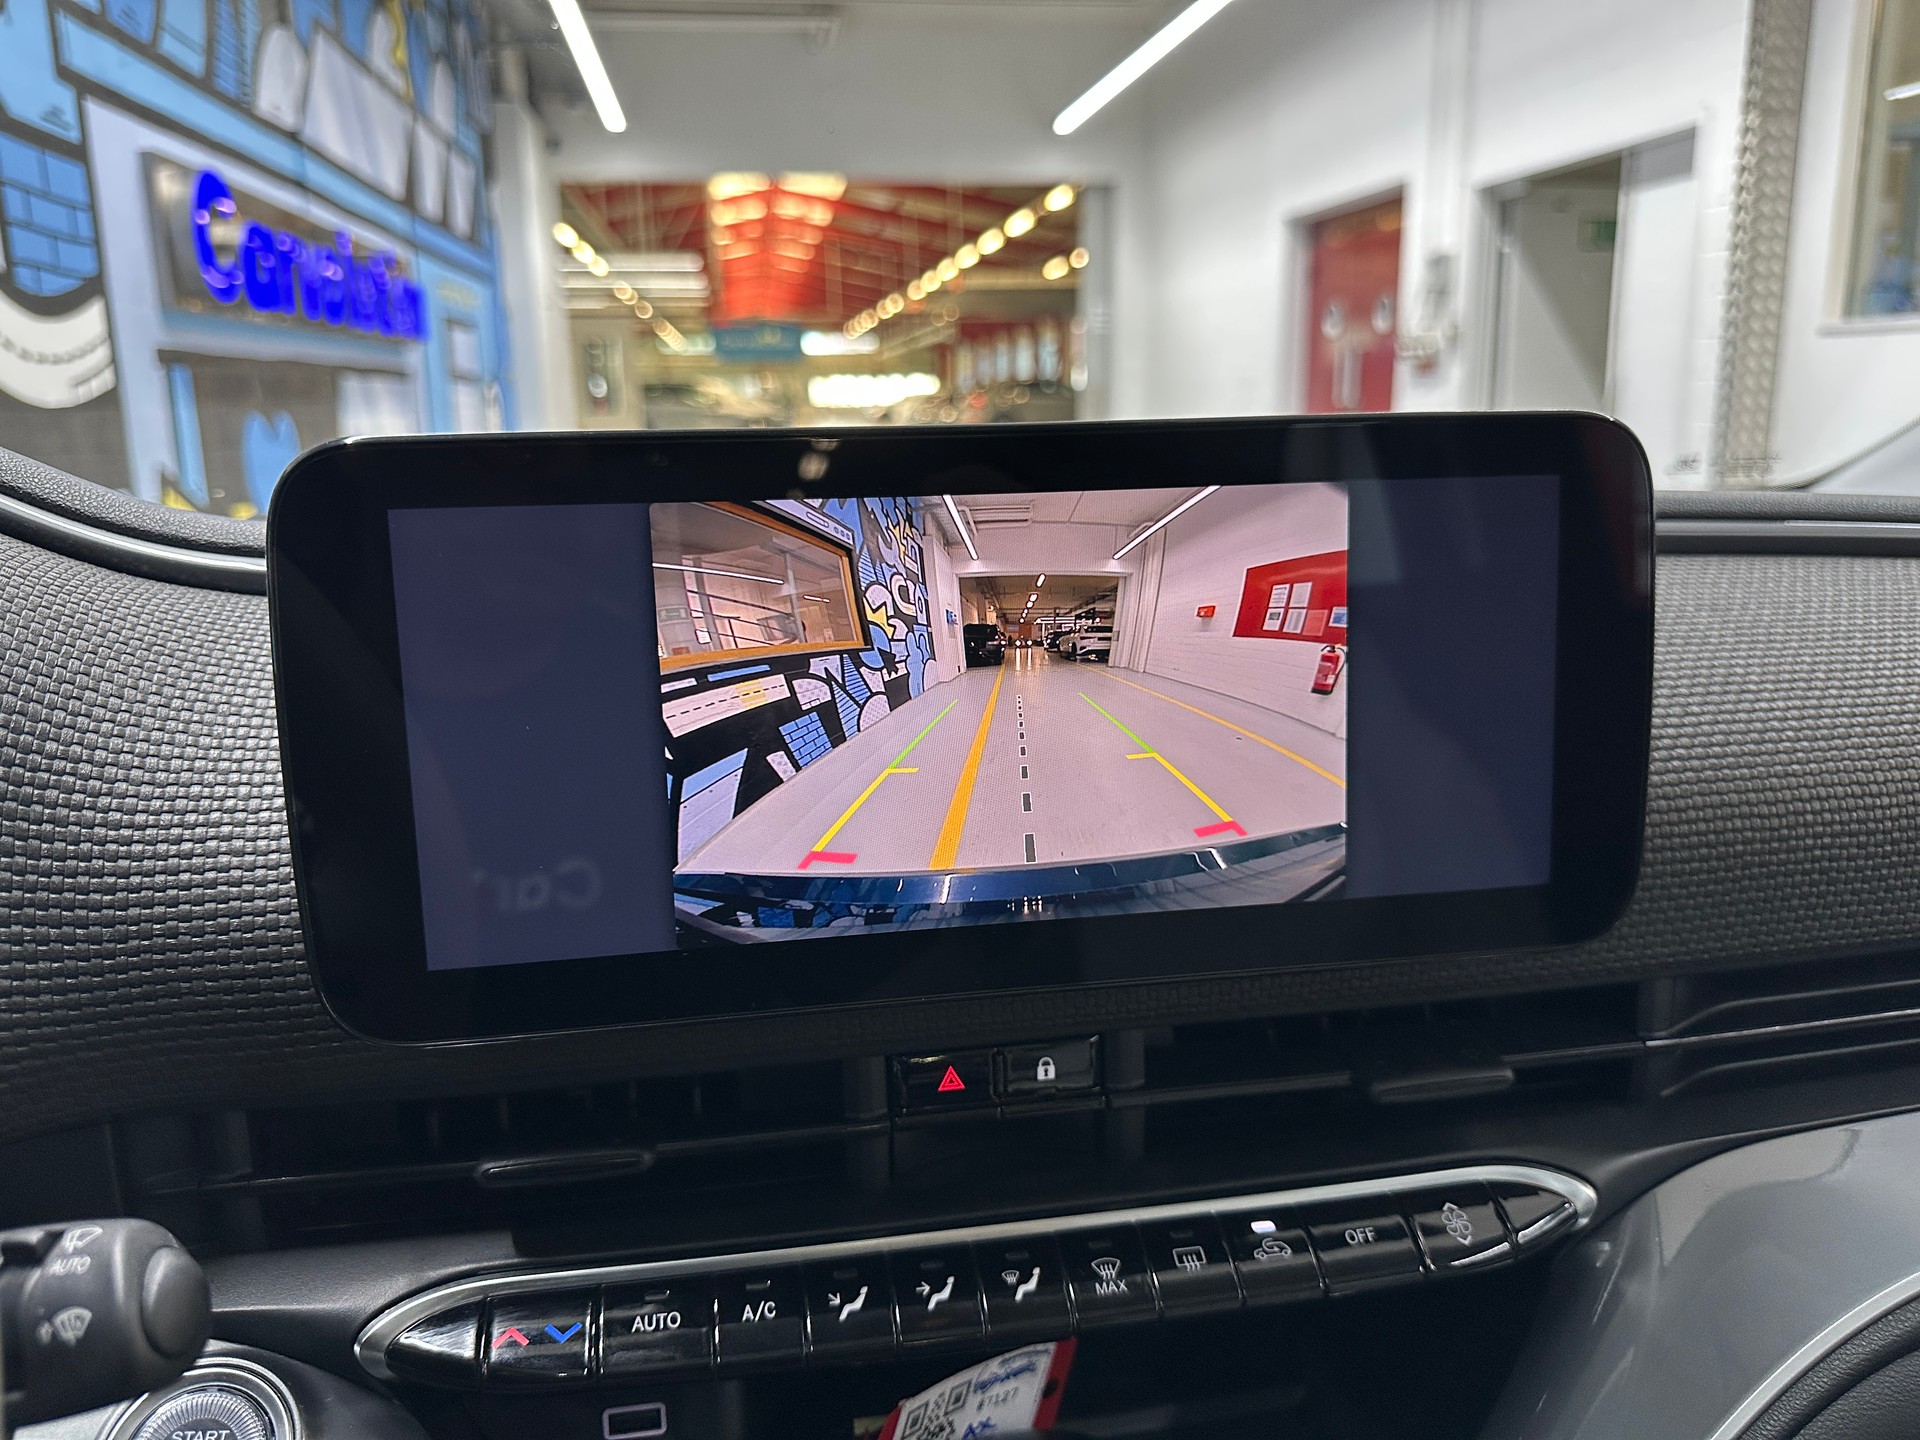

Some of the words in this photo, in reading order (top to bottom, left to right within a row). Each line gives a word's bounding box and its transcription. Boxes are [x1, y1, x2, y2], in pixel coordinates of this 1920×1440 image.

[1344, 1226, 1376, 1245] OFF
[48, 1256, 91, 1276] AUTO
[1094, 1279, 1128, 1297] MAX
[741, 1300, 776, 1323] A/C
[631, 1311, 681, 1334] AUTO
